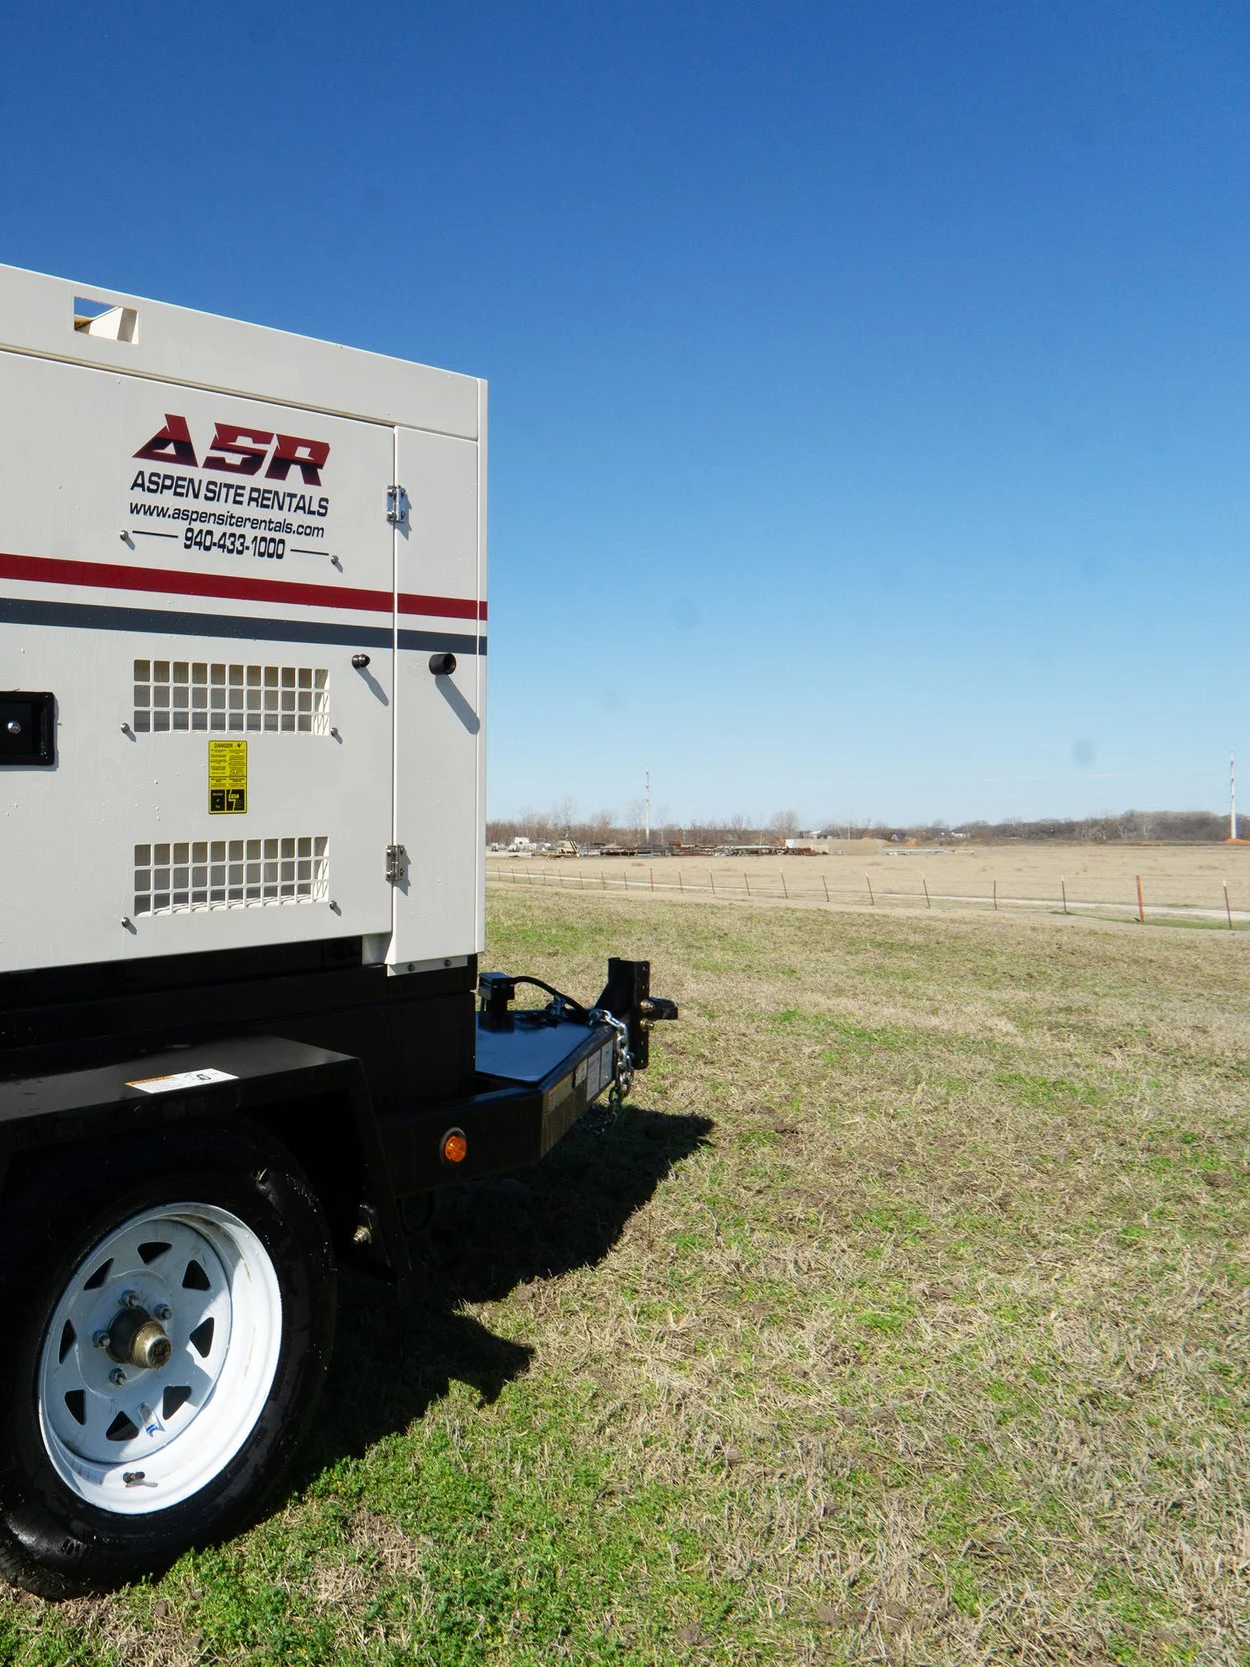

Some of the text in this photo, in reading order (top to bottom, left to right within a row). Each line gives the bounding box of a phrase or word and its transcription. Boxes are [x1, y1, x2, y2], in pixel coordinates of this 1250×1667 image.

[132, 413, 330, 487] ASR
[130, 470, 330, 517] ASPEN SITE RENTALS
[129, 502, 325, 538] www.aspensiterentals.com
[183, 528, 286, 560] 940-433-1000
